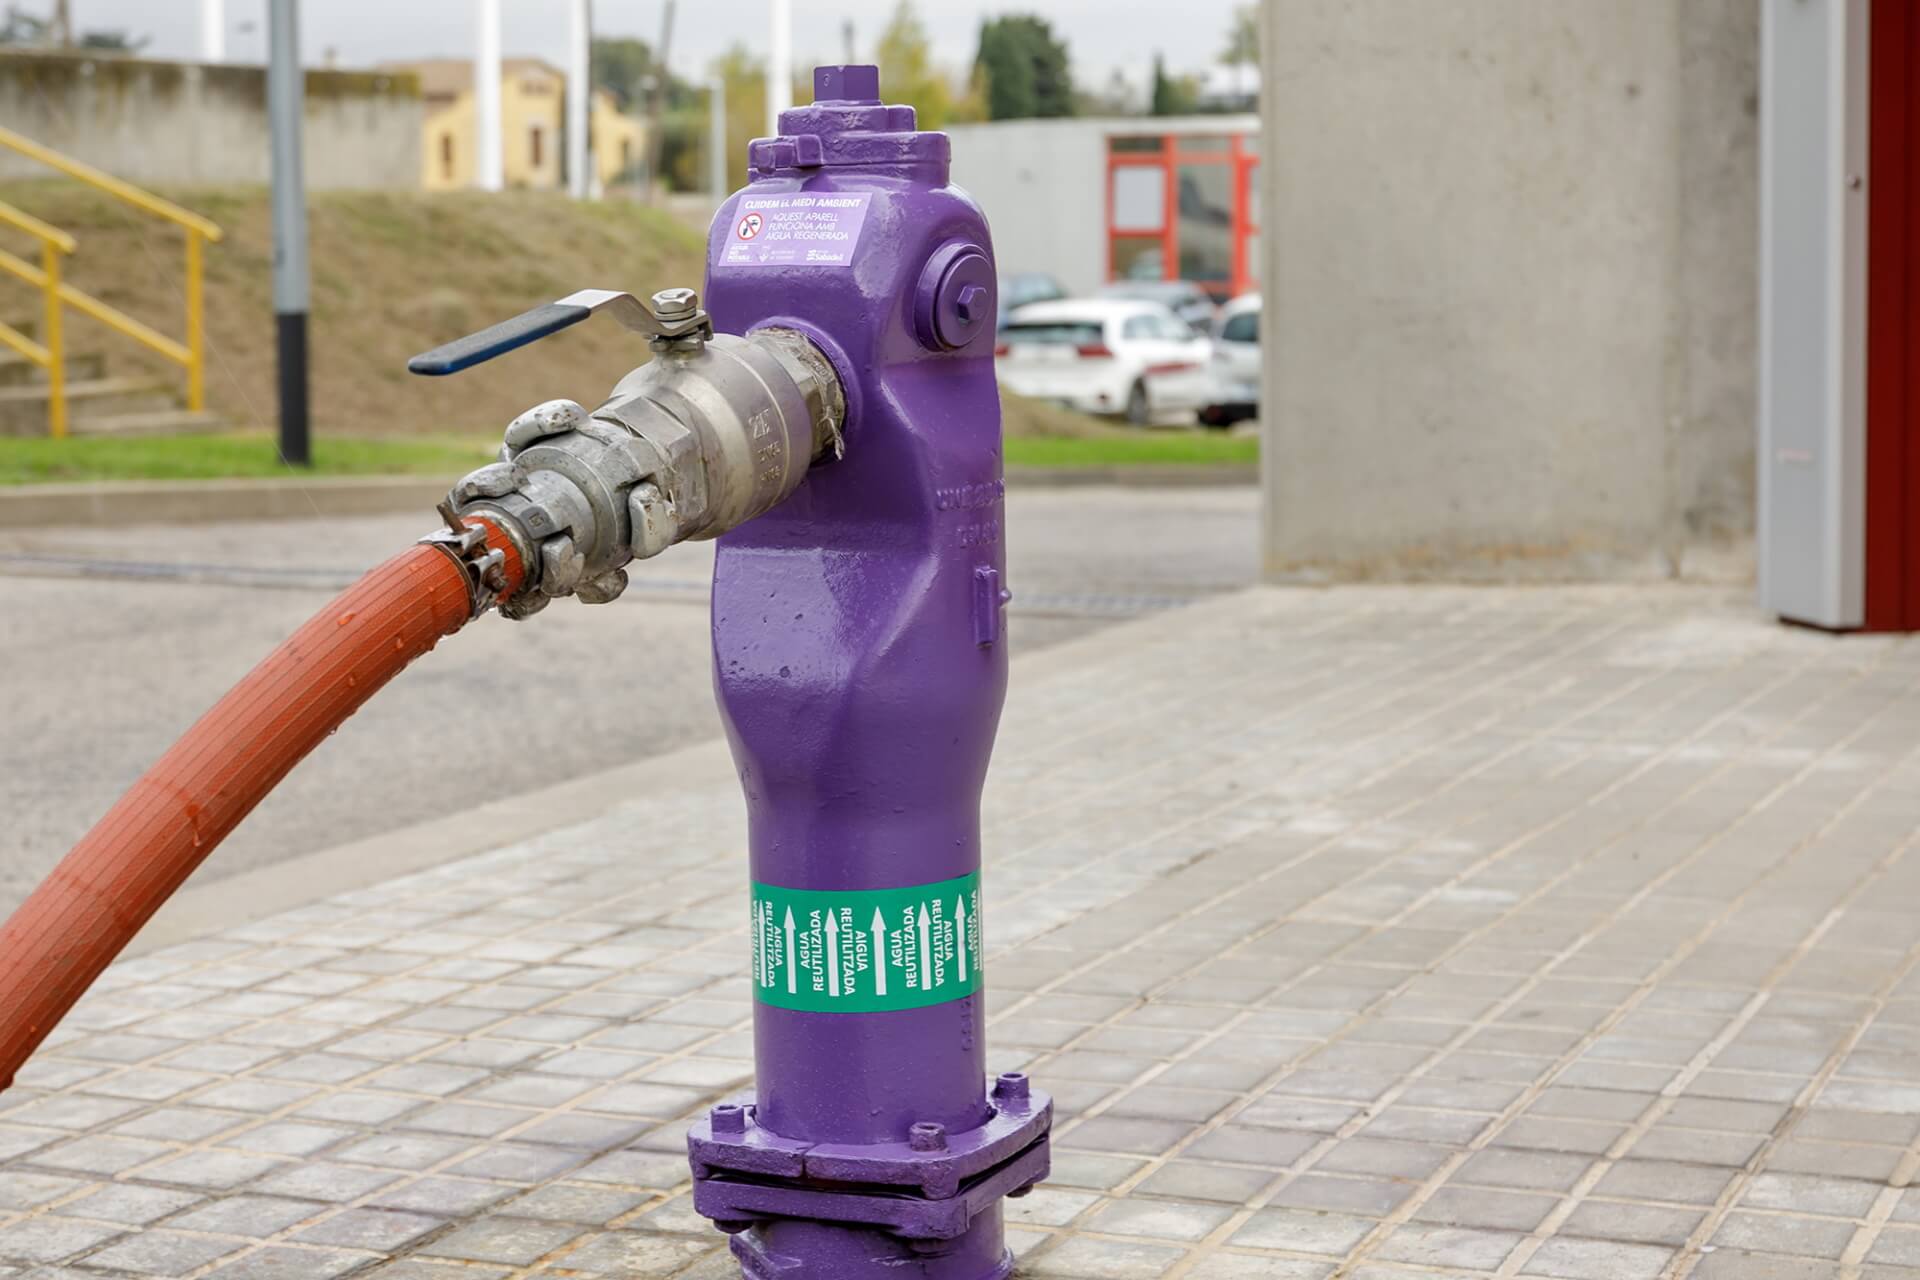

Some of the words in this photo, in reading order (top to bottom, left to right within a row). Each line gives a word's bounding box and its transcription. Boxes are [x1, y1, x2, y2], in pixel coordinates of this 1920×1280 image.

[745, 200, 780, 209] CUIDEM
[791, 198, 816, 208] MEDI
[816, 199, 862, 208] AMBIENT
[771, 212, 805, 222] AQUEST
[804, 212, 840, 222] APARELL
[764, 231, 792, 241] AIGUA
[792, 231, 849, 241] REGENERADA
[768, 222, 815, 231] FUNCIONA
[815, 222, 836, 231] AMB
[765, 901, 776, 988] REUTILITZADA
[773, 925, 783, 967] AIGUA
[799, 931, 811, 968] AGUA
[809, 909, 824, 992] REUTILIZADA
[840, 907, 856, 996] REUTILITZADA
[855, 930, 869, 972] AIGUA
[890, 929, 904, 967] AGUA
[902, 905, 918, 989] REUTILIZADA
[931, 898, 945, 987] REUTILITZADA
[943, 920, 954, 961] AIGUA
